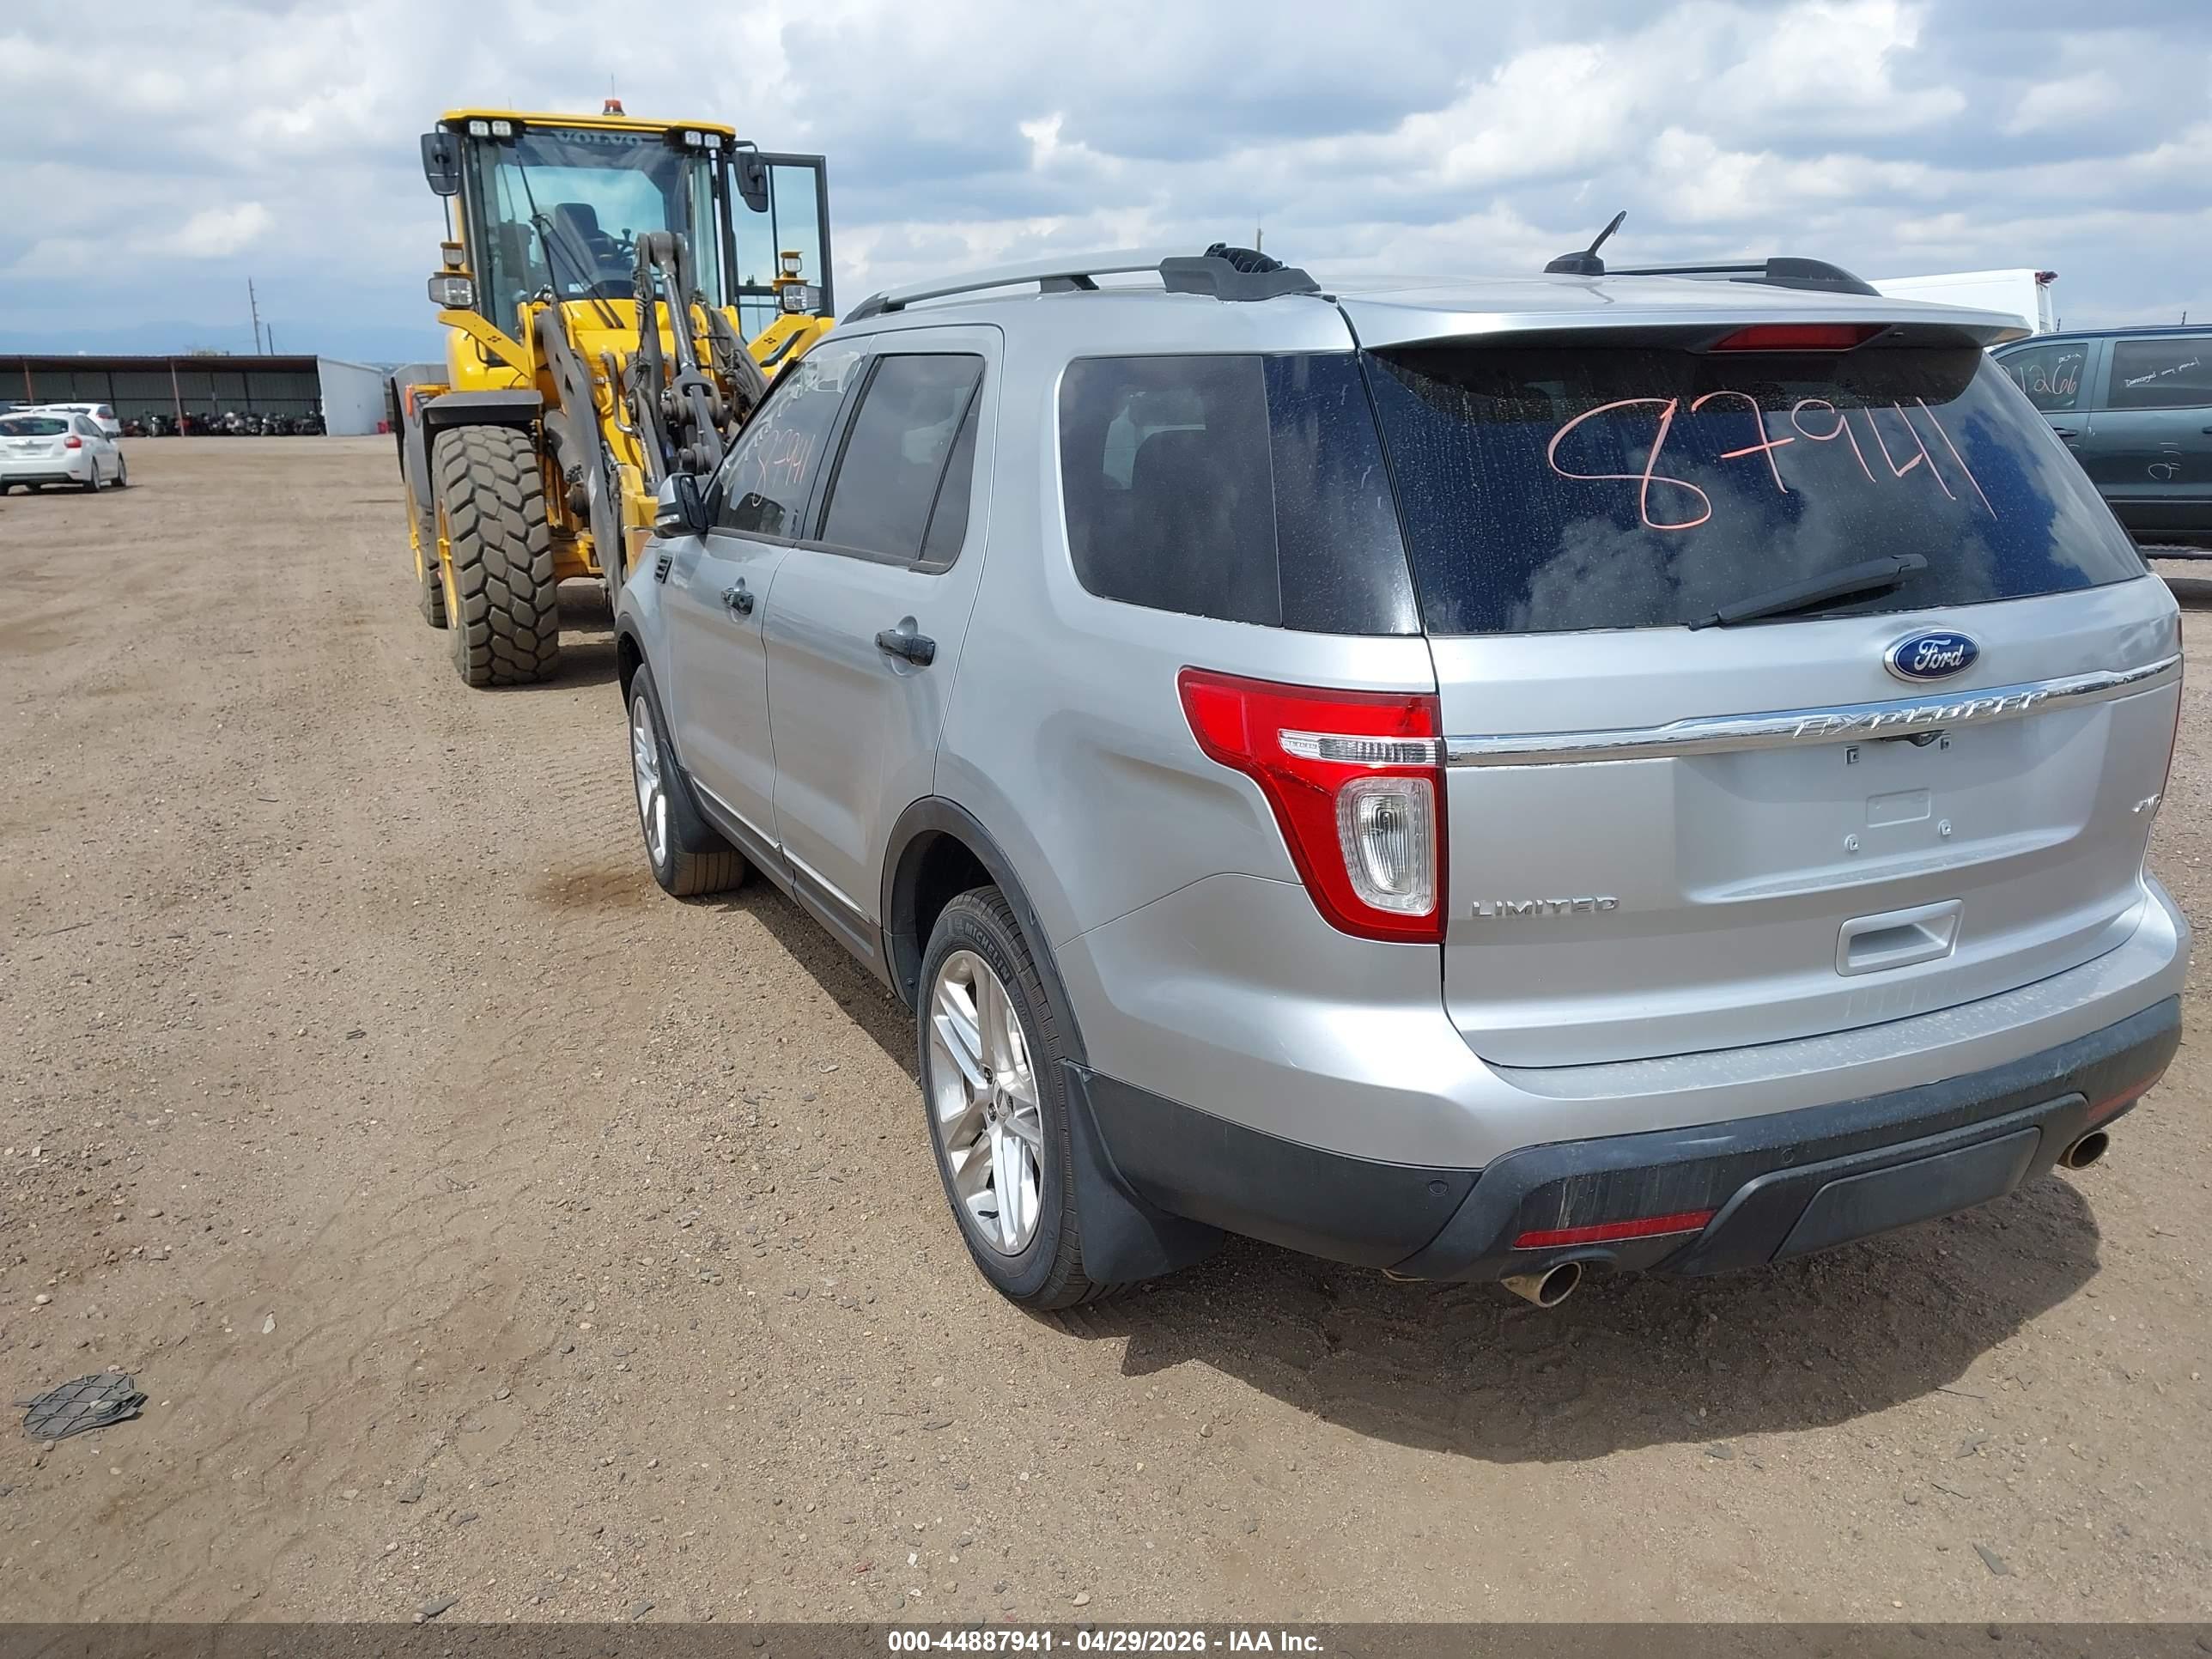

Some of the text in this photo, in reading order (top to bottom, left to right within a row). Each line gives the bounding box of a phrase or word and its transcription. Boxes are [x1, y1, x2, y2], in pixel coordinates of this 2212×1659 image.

[550, 130, 643, 147] VOLVO
[1548, 392, 1997, 529] 87941
[1913, 638, 1965, 672] Ford
[1793, 688, 2049, 738] EXPLORER
[1472, 896, 1620, 917] LIMITED
[964, 921, 1012, 985] MICHELIN
